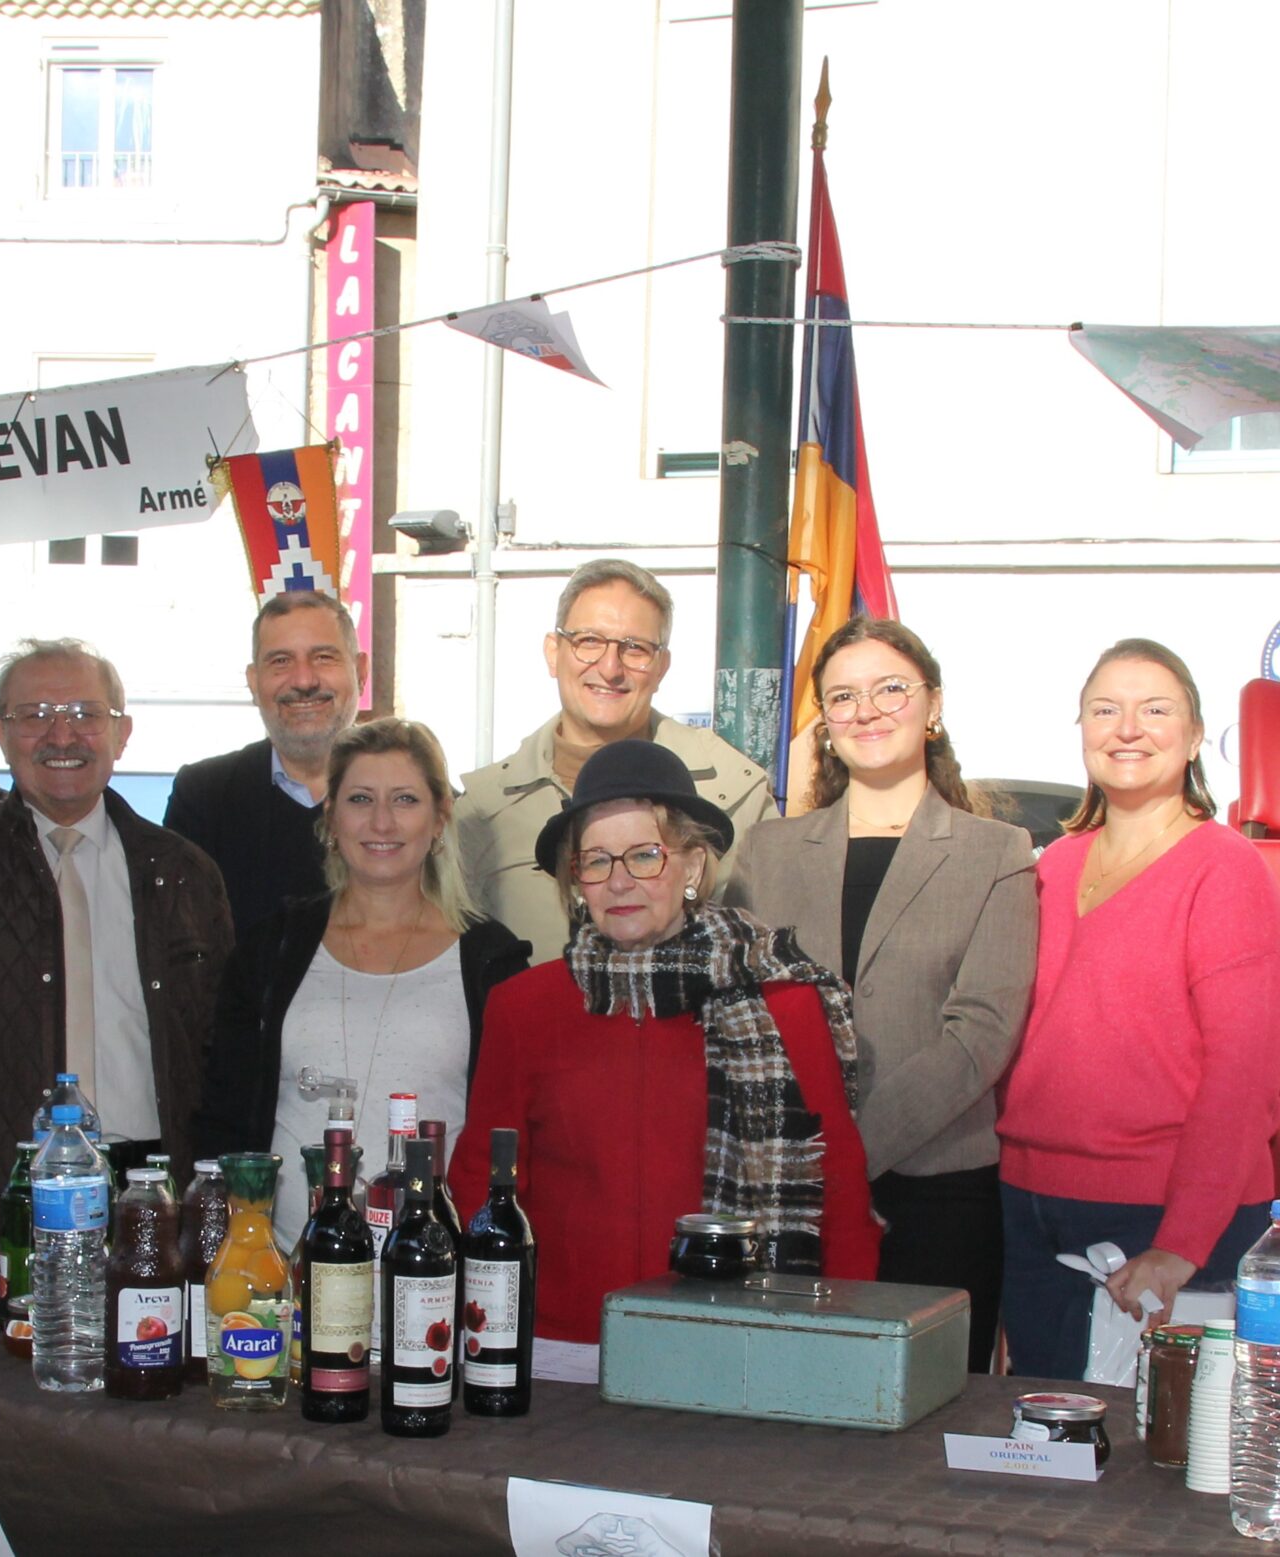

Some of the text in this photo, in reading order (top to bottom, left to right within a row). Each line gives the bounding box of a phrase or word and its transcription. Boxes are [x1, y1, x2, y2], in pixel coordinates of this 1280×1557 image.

[225, 1334, 278, 1352] Ararat
[1004, 1441, 1034, 1451] PAIN
[989, 1451, 1052, 1463] ORIENTAL
